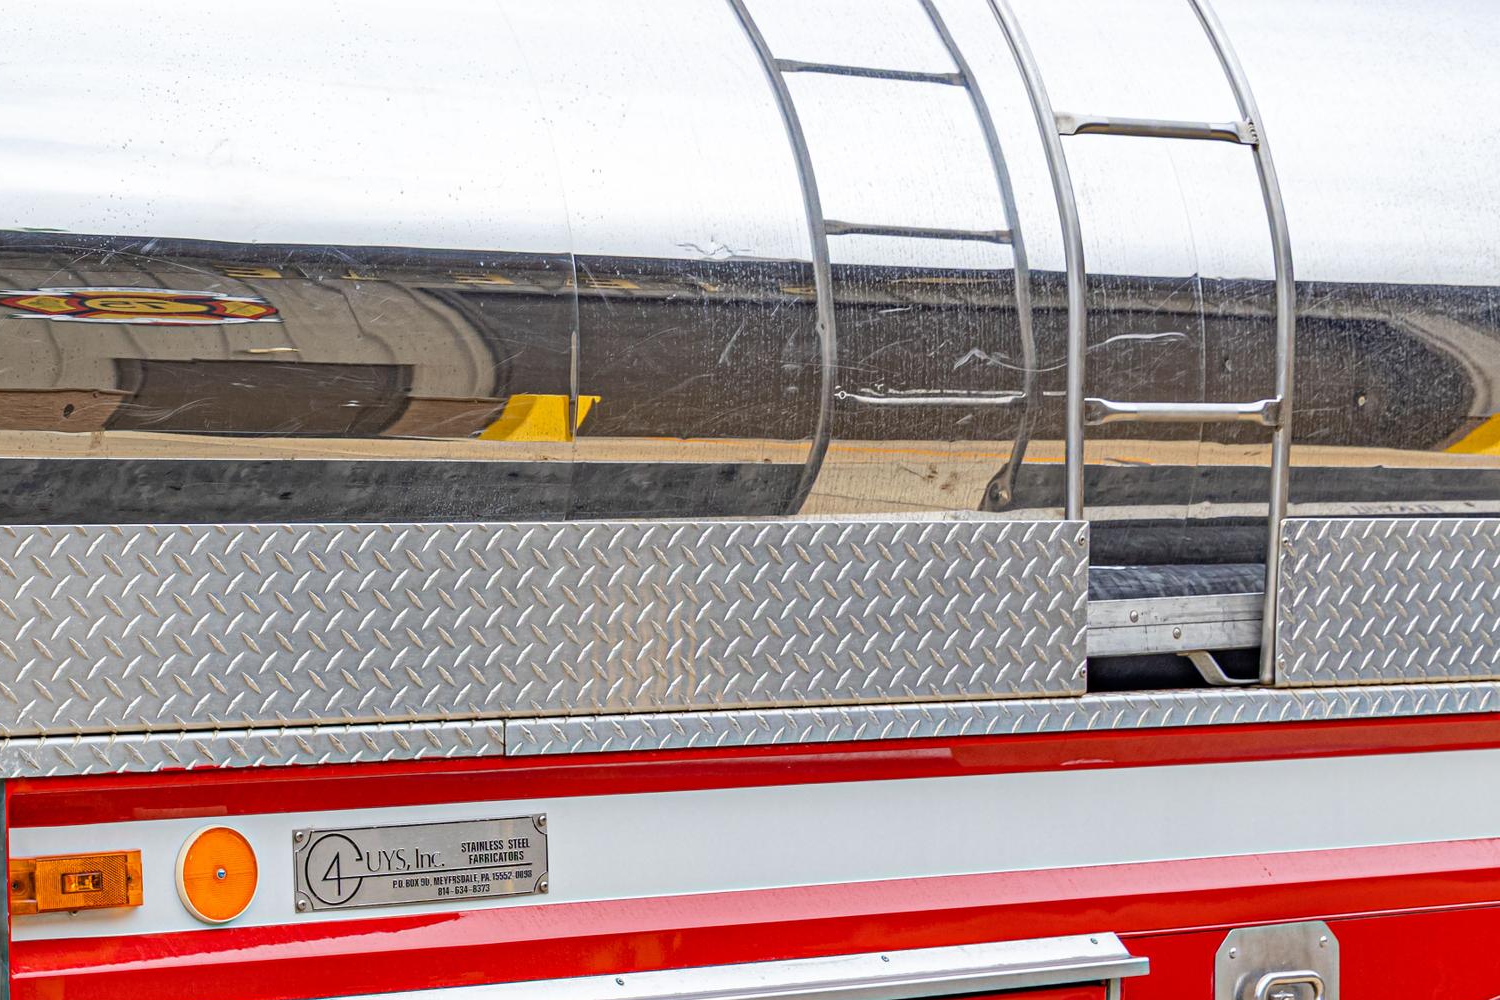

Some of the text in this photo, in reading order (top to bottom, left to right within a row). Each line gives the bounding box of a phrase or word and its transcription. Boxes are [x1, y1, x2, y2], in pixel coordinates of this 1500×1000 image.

[461, 838, 530, 853] STAINLESS STEEL
[415, 848, 445, 868] Inc.
[468, 850, 524, 865] FABRICATORS
[405, 879, 420, 888] BOX
[438, 884, 491, 896] 814-634-8373
